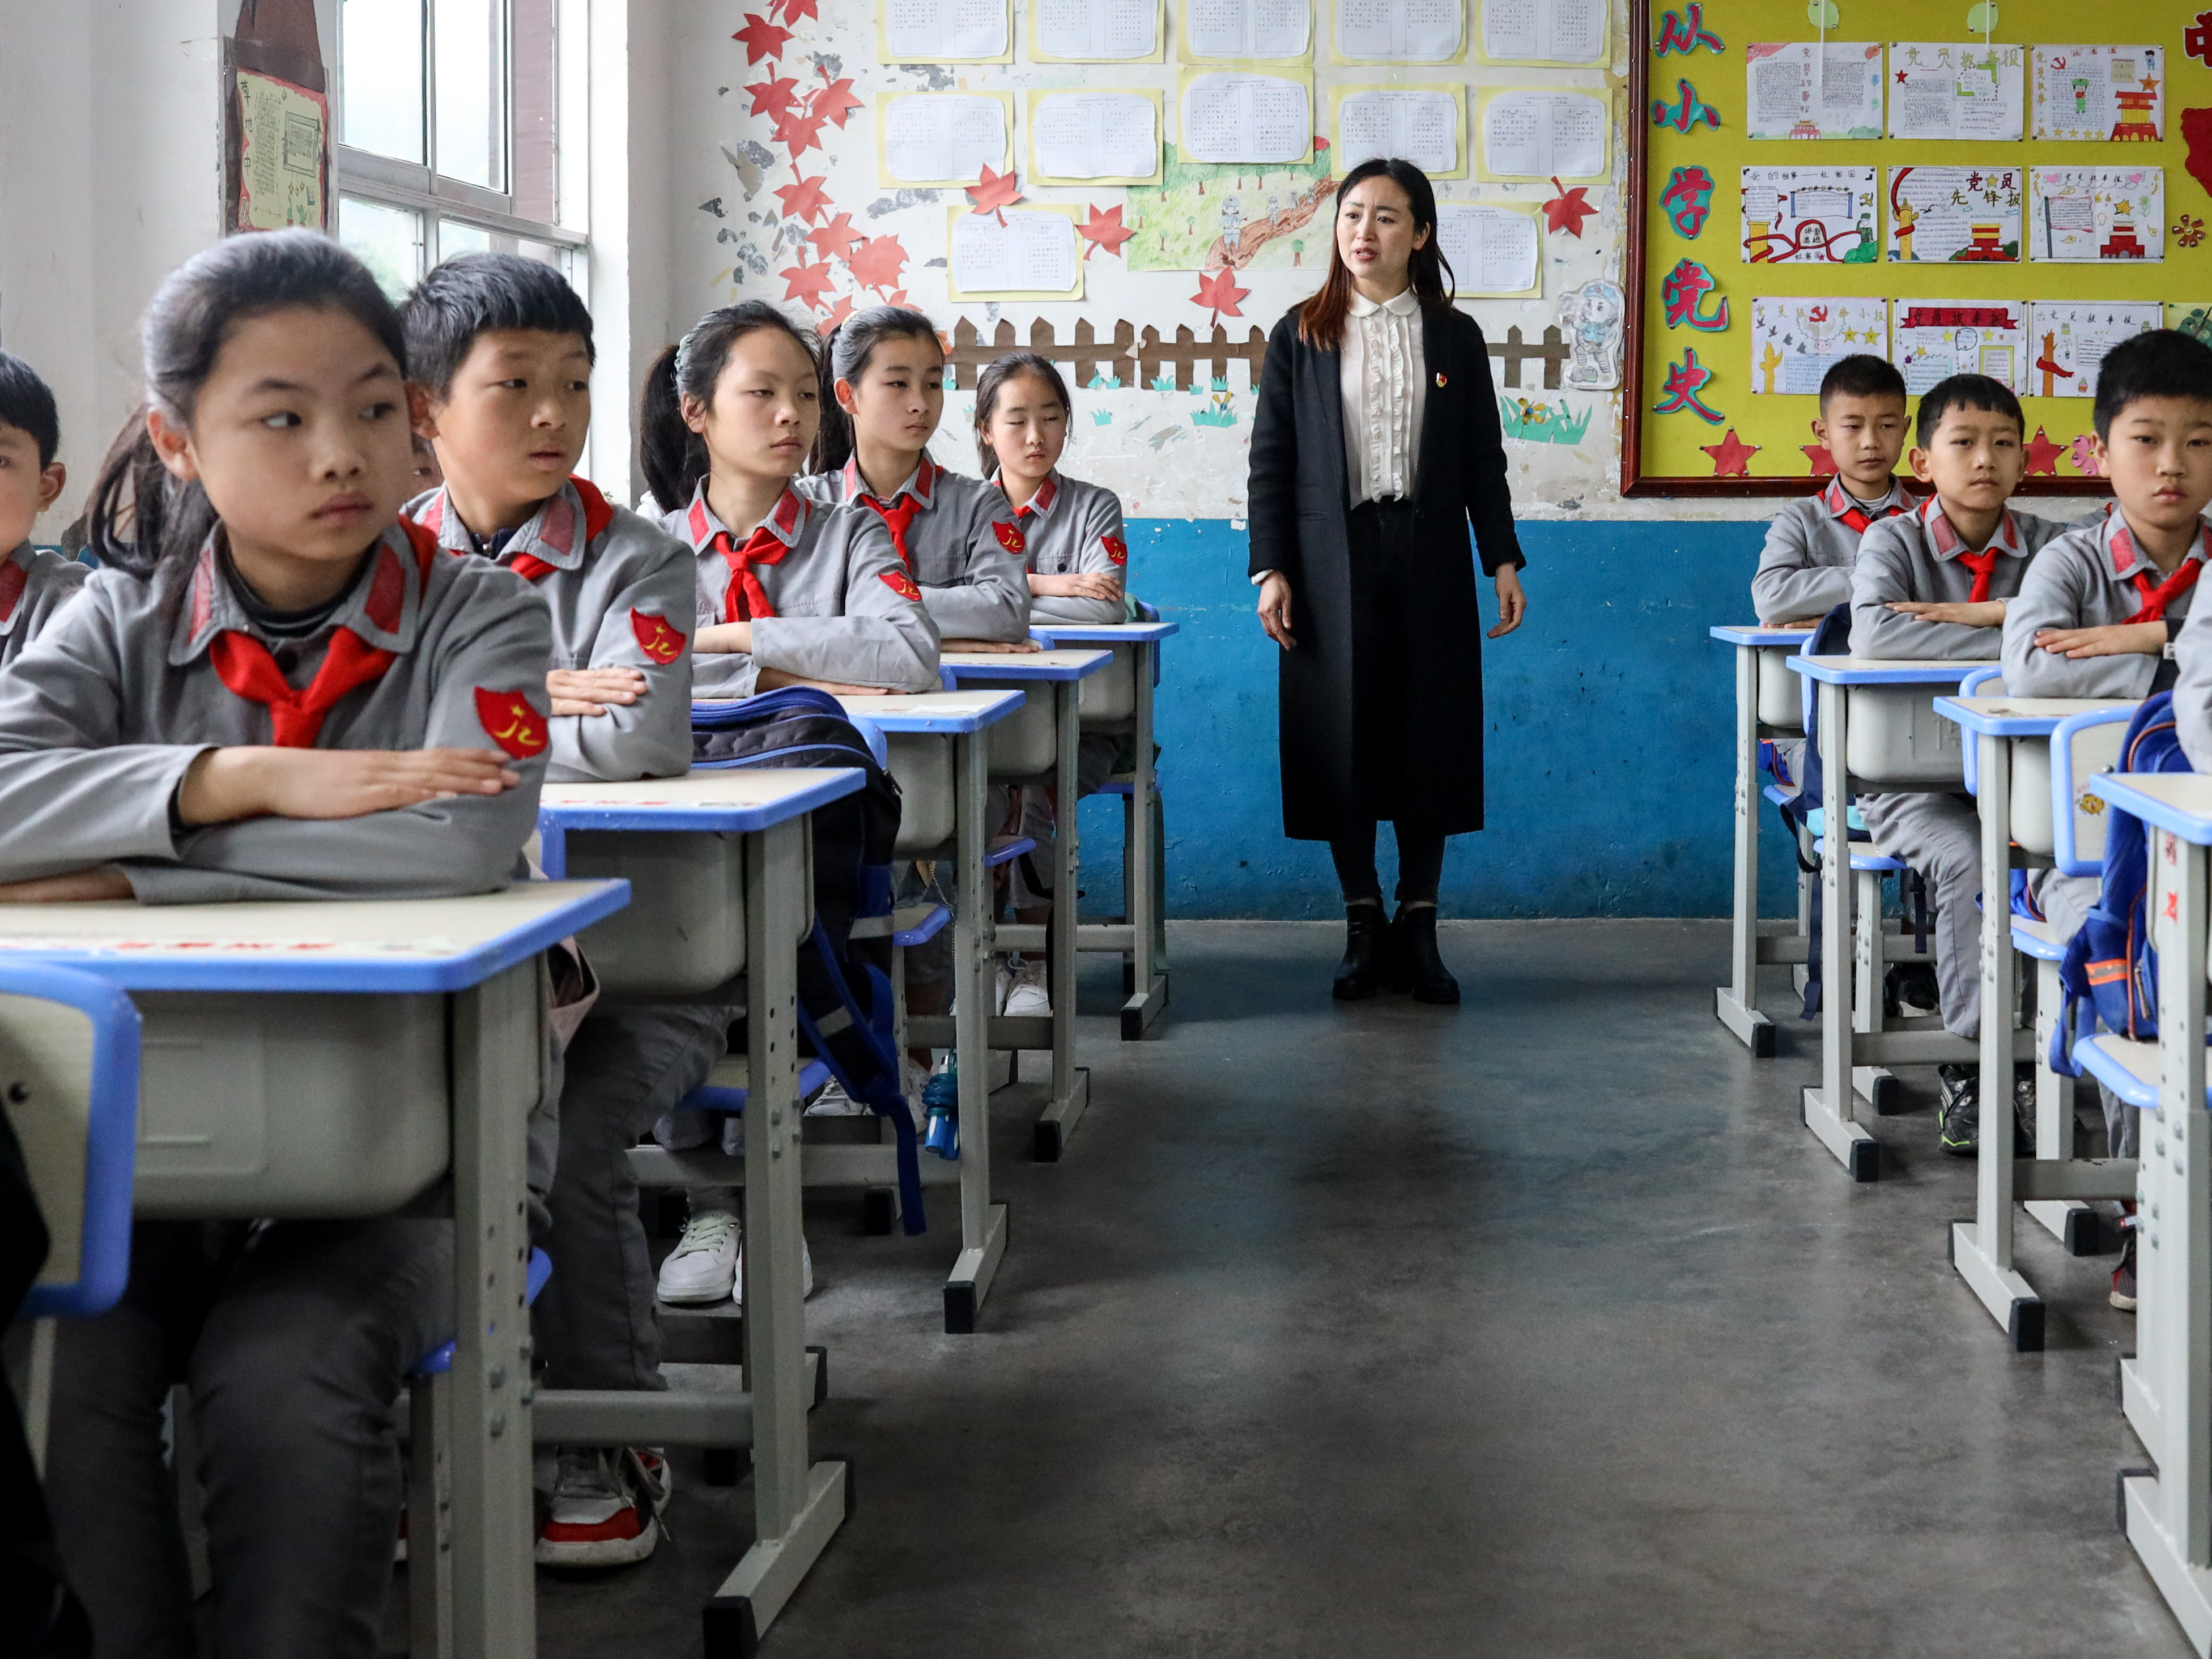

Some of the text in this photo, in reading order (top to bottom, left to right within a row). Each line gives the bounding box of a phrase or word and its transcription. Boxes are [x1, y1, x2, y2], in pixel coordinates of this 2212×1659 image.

[1905, 46, 2021, 70] 党员故事报
[1800, 47, 1813, 113] 党员故事报
[1966, 171, 2017, 192] 党员
[1951, 189, 2020, 207] 先锋报
[1655, 5, 1728, 424] 从小学党史
